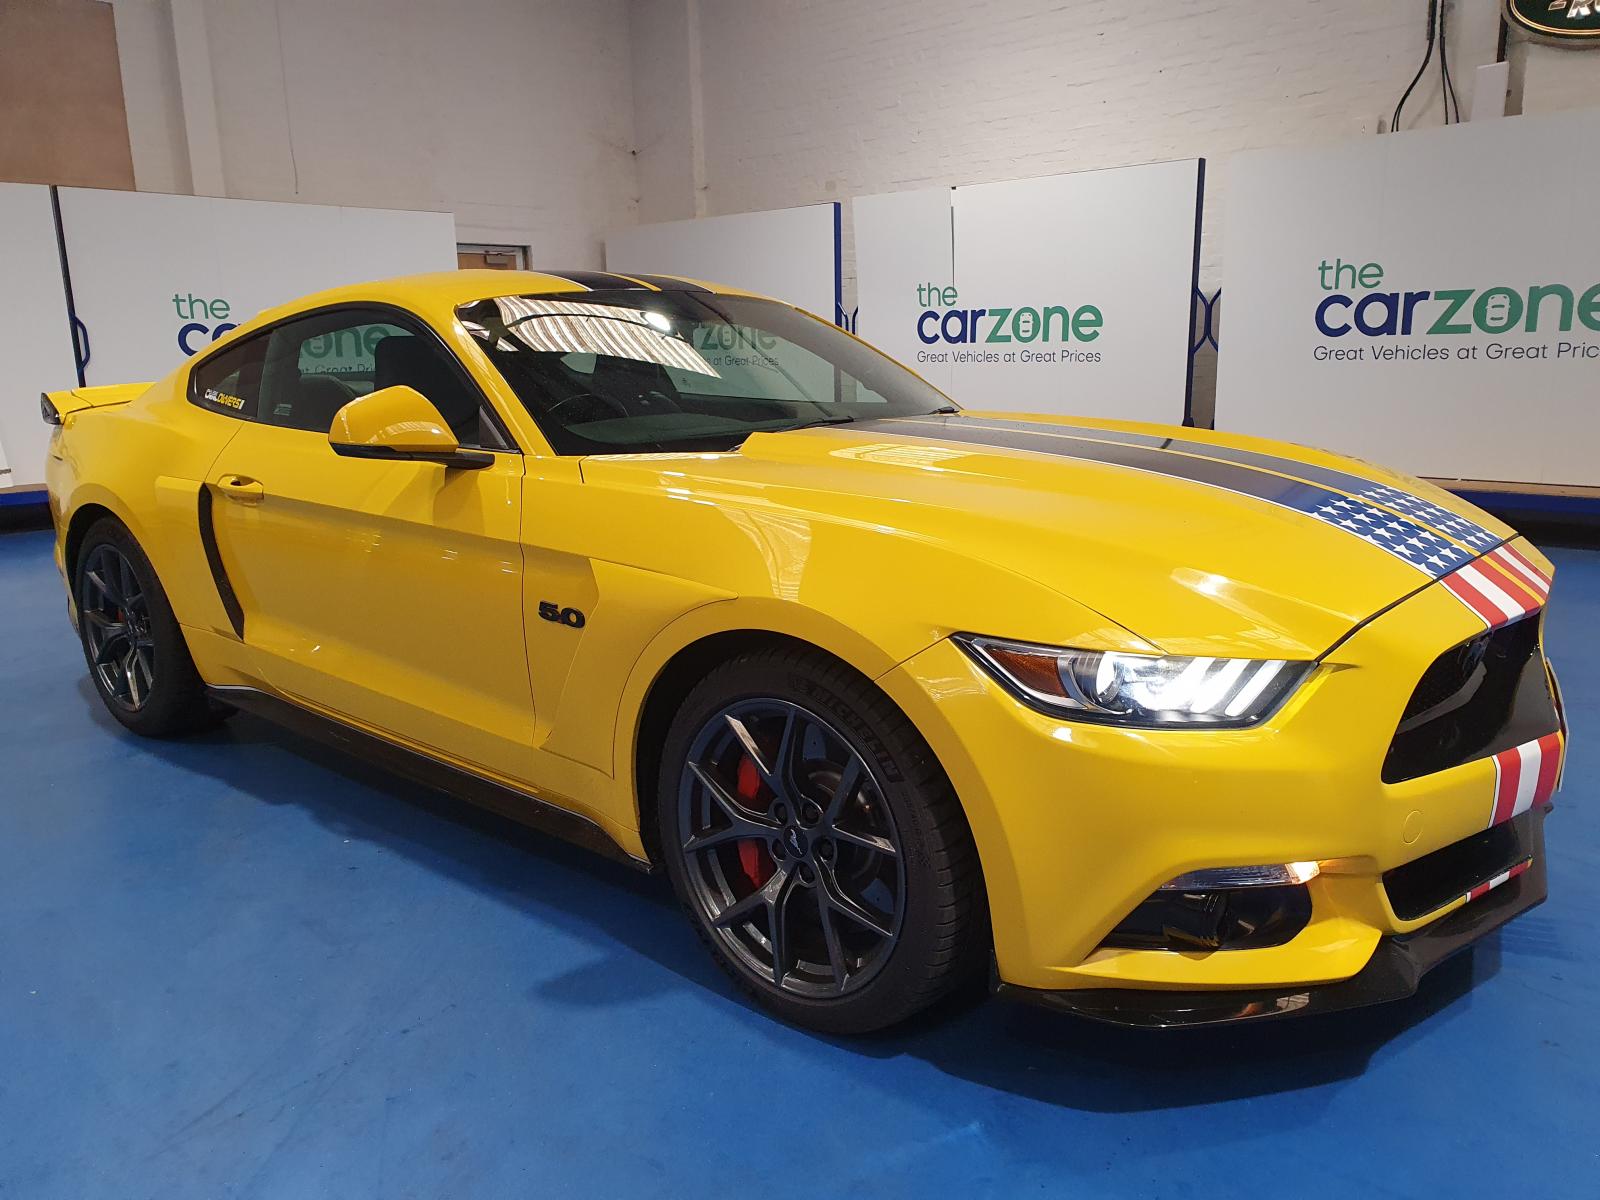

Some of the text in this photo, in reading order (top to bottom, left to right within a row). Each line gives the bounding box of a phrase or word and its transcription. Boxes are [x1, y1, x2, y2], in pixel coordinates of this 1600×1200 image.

[1317, 258, 1385, 291] the
[172, 293, 231, 320] the
[917, 282, 958, 308] the
[916, 304, 1104, 345] carzone
[916, 349, 1102, 363] Great Vehicles at Great Prices
[1313, 345, 1365, 361] Great
[1370, 344, 1450, 361] Vehicles
[1456, 345, 1478, 361] at
[1485, 343, 1548, 361] Great
[538, 600, 586, 629] 5.0
